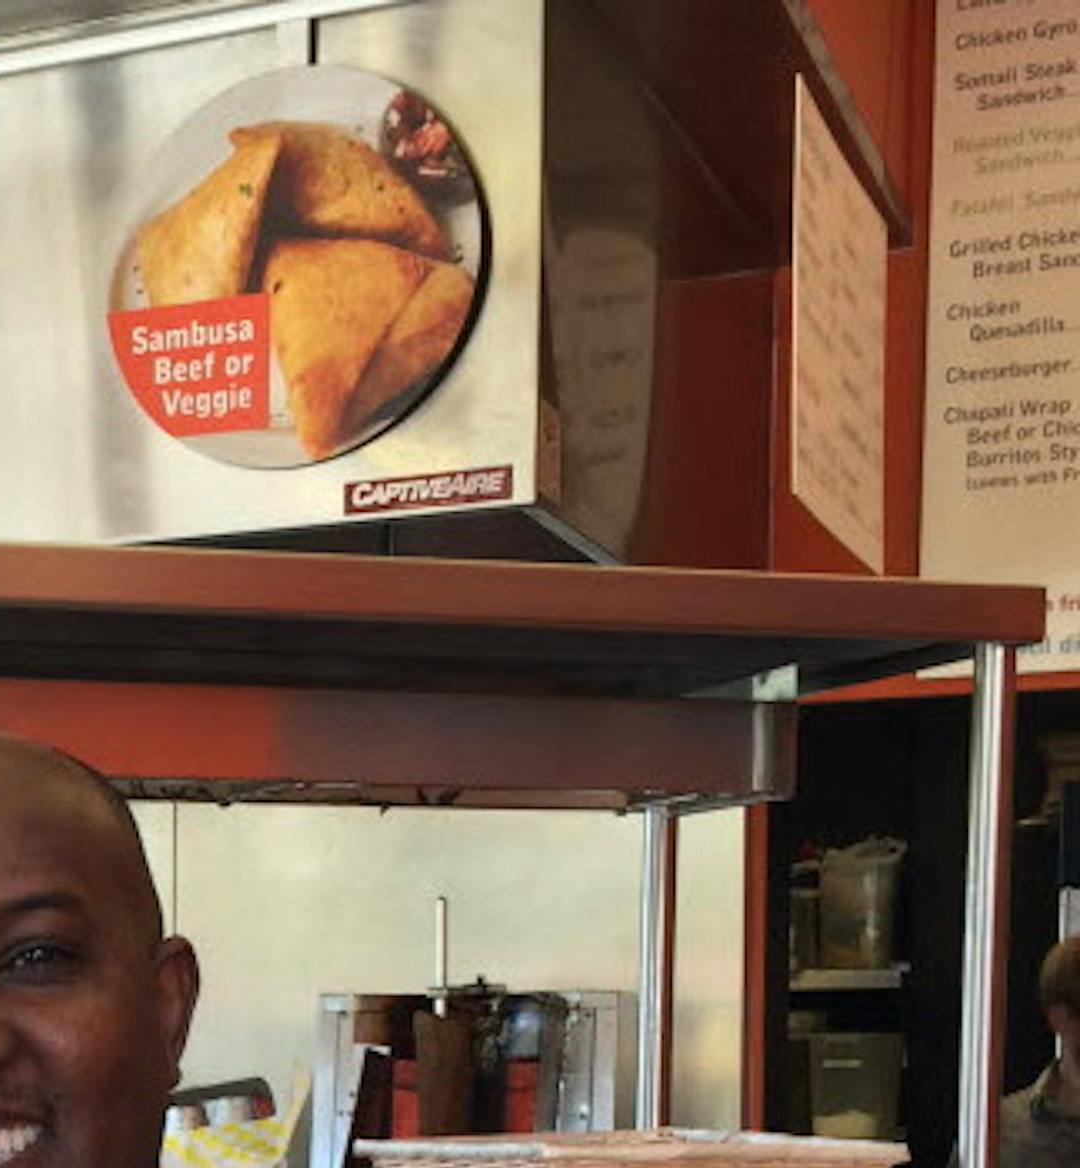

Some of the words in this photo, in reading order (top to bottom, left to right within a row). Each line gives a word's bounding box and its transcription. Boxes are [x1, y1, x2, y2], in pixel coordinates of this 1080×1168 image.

[956, 26, 1027, 51] Chicken
[1025, 57, 1077, 81] Steak
[949, 236, 1011, 259] Grilled
[972, 256, 1031, 279] Breast
[946, 300, 1020, 321] Chicken
[132, 319, 255, 355] Sambusa
[969, 315, 1065, 343] Quesadilla
[154, 350, 216, 386] Beef
[225, 353, 255, 377] or
[945, 358, 1072, 385] Cheeseburger
[162, 382, 252, 419] Veggie
[1019, 398, 1072, 418] Wrap
[966, 423, 1011, 445] Beef
[1016, 426, 1037, 441] or
